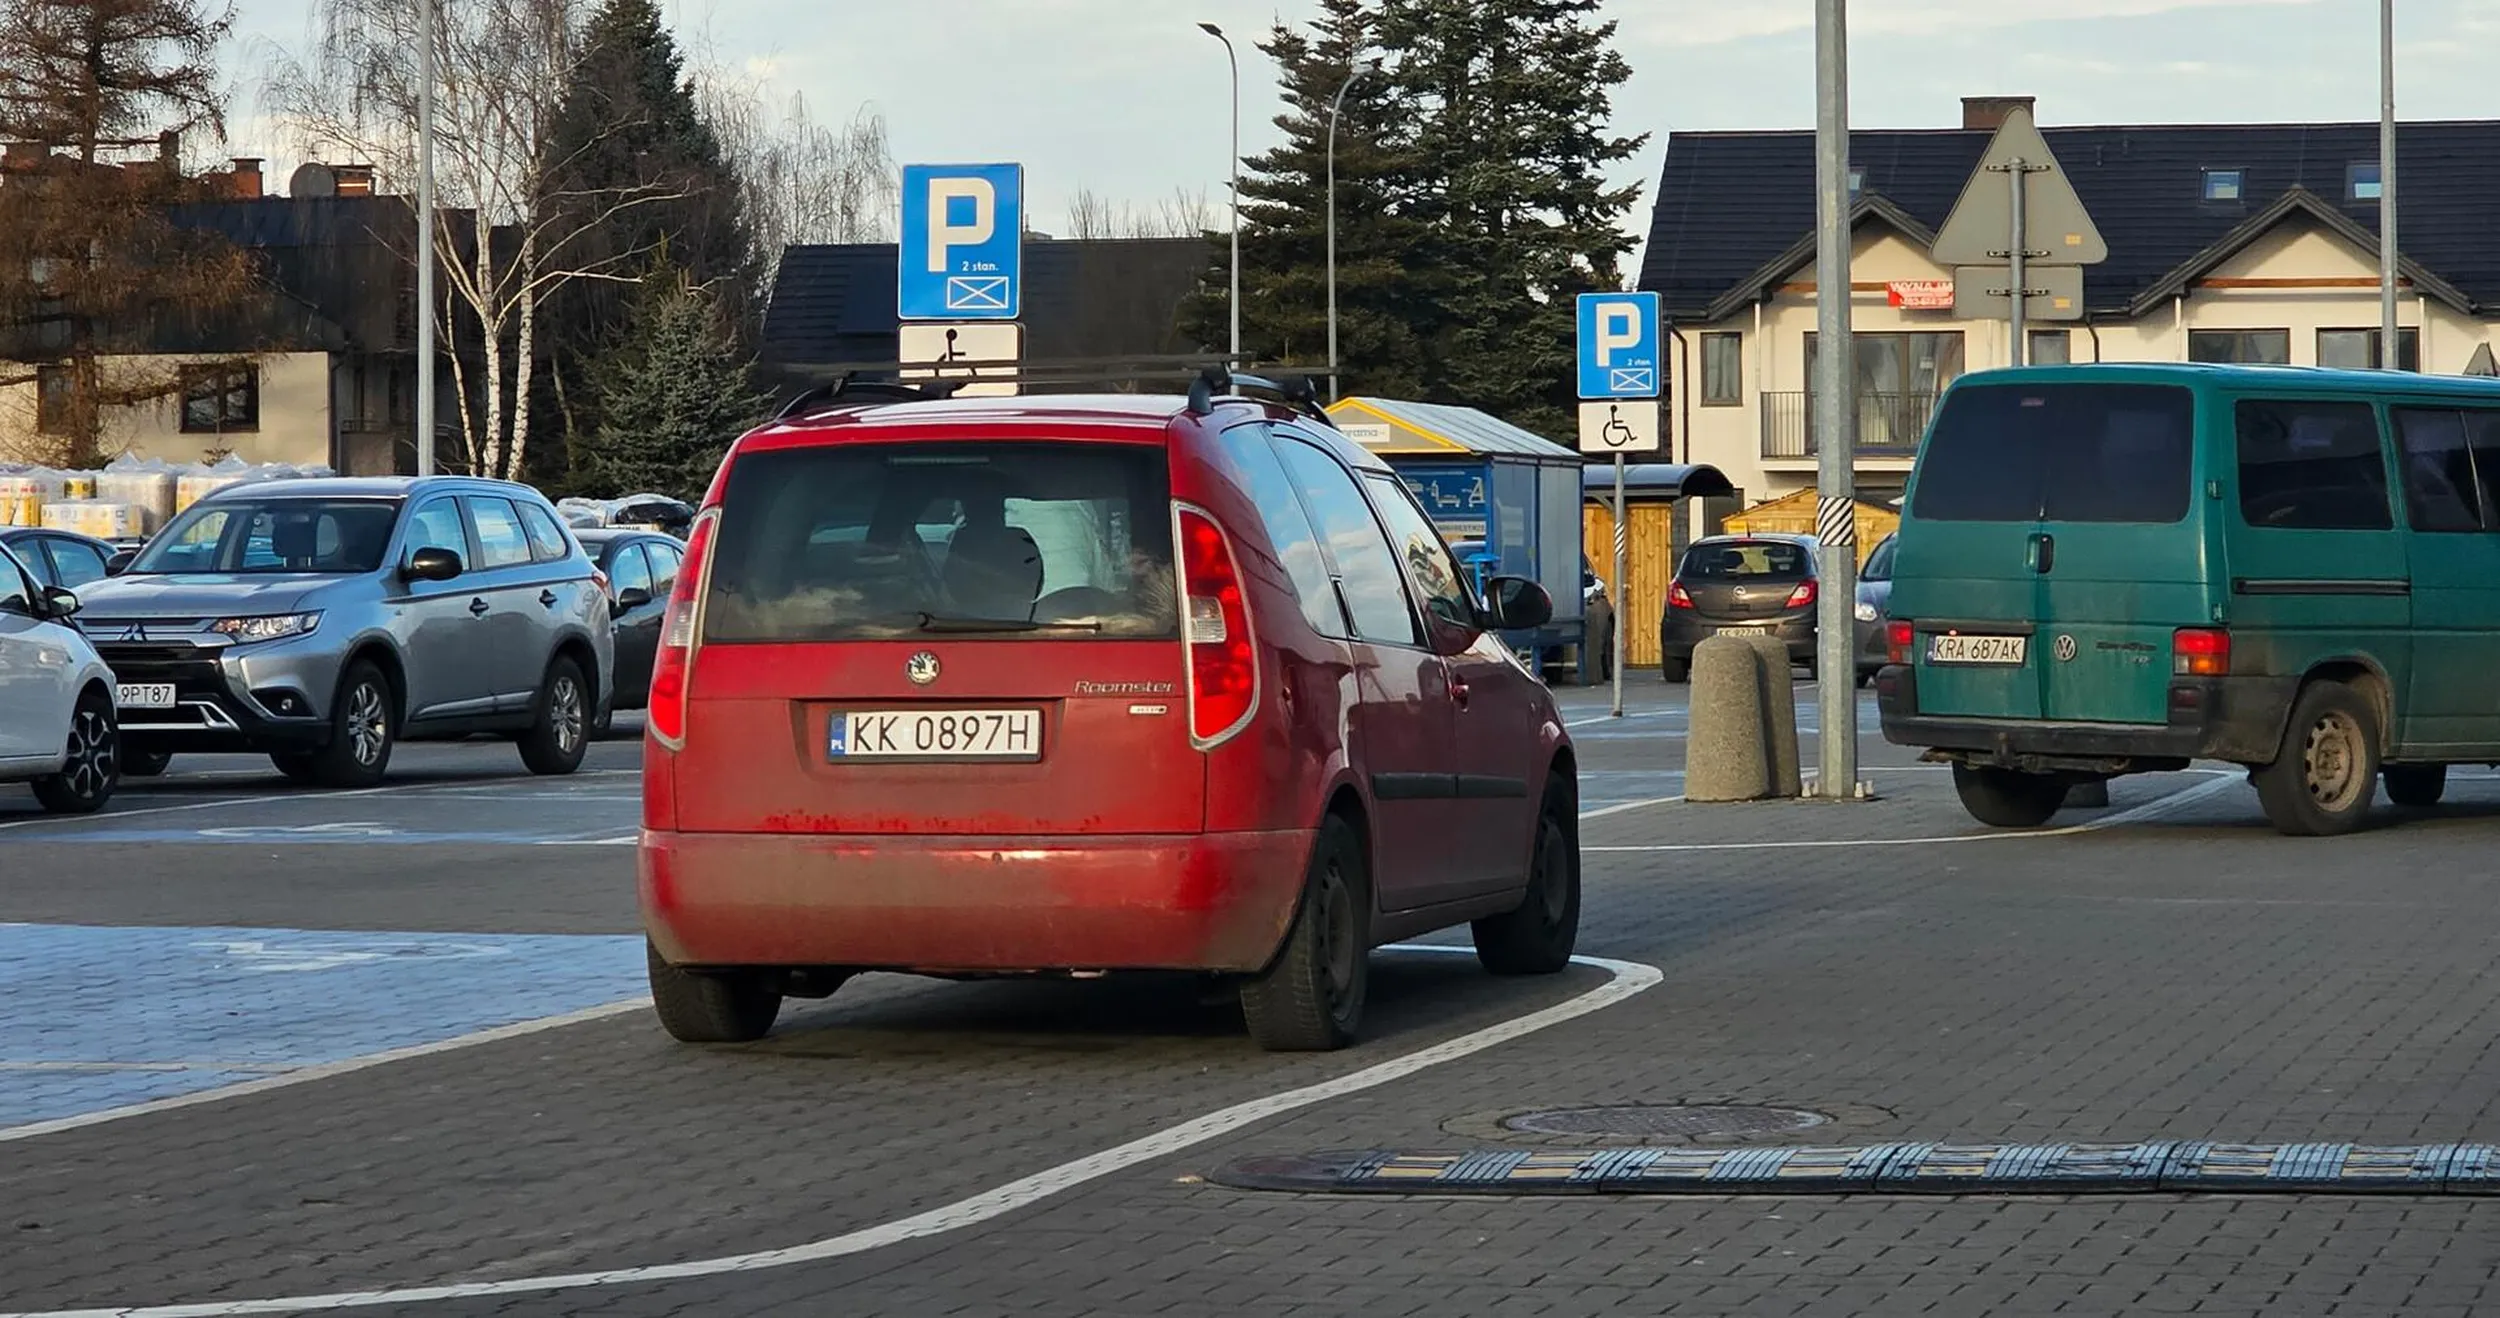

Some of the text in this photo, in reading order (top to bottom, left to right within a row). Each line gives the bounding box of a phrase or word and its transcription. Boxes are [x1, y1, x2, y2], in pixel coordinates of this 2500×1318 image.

[928, 177, 995, 272] P
[962, 260, 999, 271] 2 stan.
[1596, 303, 1641, 367] P
[1627, 358, 1633, 366] 2
[1935, 638, 2021, 660] KRA 687AK
[121, 686, 170, 703] 9PT87
[1074, 680, 1172, 693] Roomster
[854, 714, 1029, 751] KK 0897H
[831, 739, 844, 750] PL
